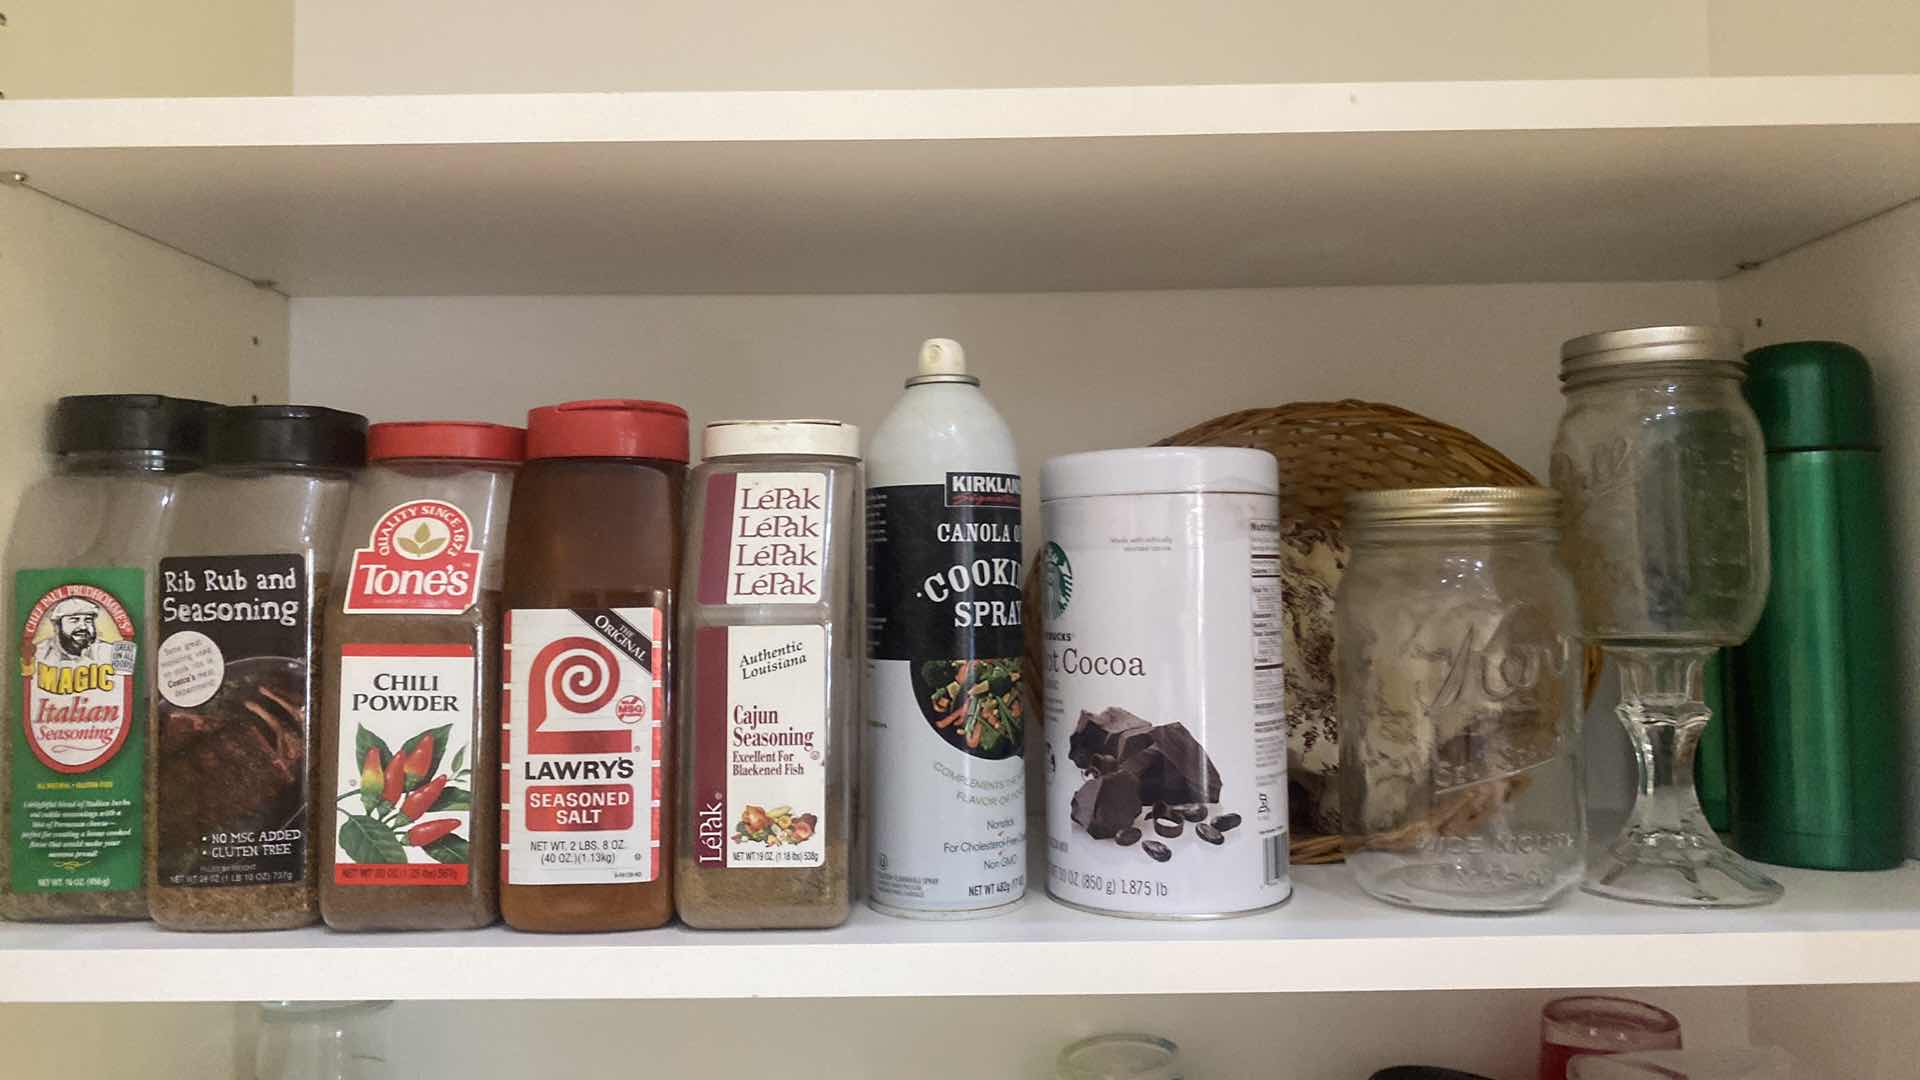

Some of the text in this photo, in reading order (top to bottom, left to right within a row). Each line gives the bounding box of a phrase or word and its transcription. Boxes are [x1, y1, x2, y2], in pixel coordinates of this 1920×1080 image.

[741, 488, 821, 509] LéPak
[378, 505, 465, 557] QUALITY SINCE 1873
[738, 515, 819, 537] LéPak
[937, 523, 1009, 542] CANOLA
[735, 543, 817, 566] LéPak
[164, 567, 297, 593] Rib Rub and
[360, 564, 468, 596] Tone's
[734, 572, 816, 595] LéPak
[163, 597, 299, 627] Seasoning
[594, 614, 647, 661] ORIGINAL
[739, 641, 804, 668] Authentic
[1063, 648, 1146, 677] Cocoa
[742, 654, 808, 680] Louisiana
[38, 663, 115, 695] MAGIC
[373, 674, 439, 691] CHILI
[33, 696, 120, 724] Italian
[352, 694, 460, 712] POWDER
[733, 704, 778, 730] Cajun
[38, 725, 114, 745] Seasoning
[733, 727, 815, 751] Seasoning
[732, 750, 794, 763] Excellent For
[524, 757, 635, 781] LAWRY'S
[732, 762, 804, 776] Blackened Fish
[530, 791, 630, 808] SEASONED
[556, 810, 602, 825] SALT
[211, 829, 301, 845] NO MSG ADDED
[699, 802, 723, 864] LéPak
[211, 843, 291, 858] GLUTEN FREE
[530, 840, 548, 852] NET
[569, 841, 577, 851] 2
[601, 840, 608, 850] 8
[541, 853, 557, 865] (40
[968, 884, 982, 897] NET
[1156, 881, 1168, 896] lb
